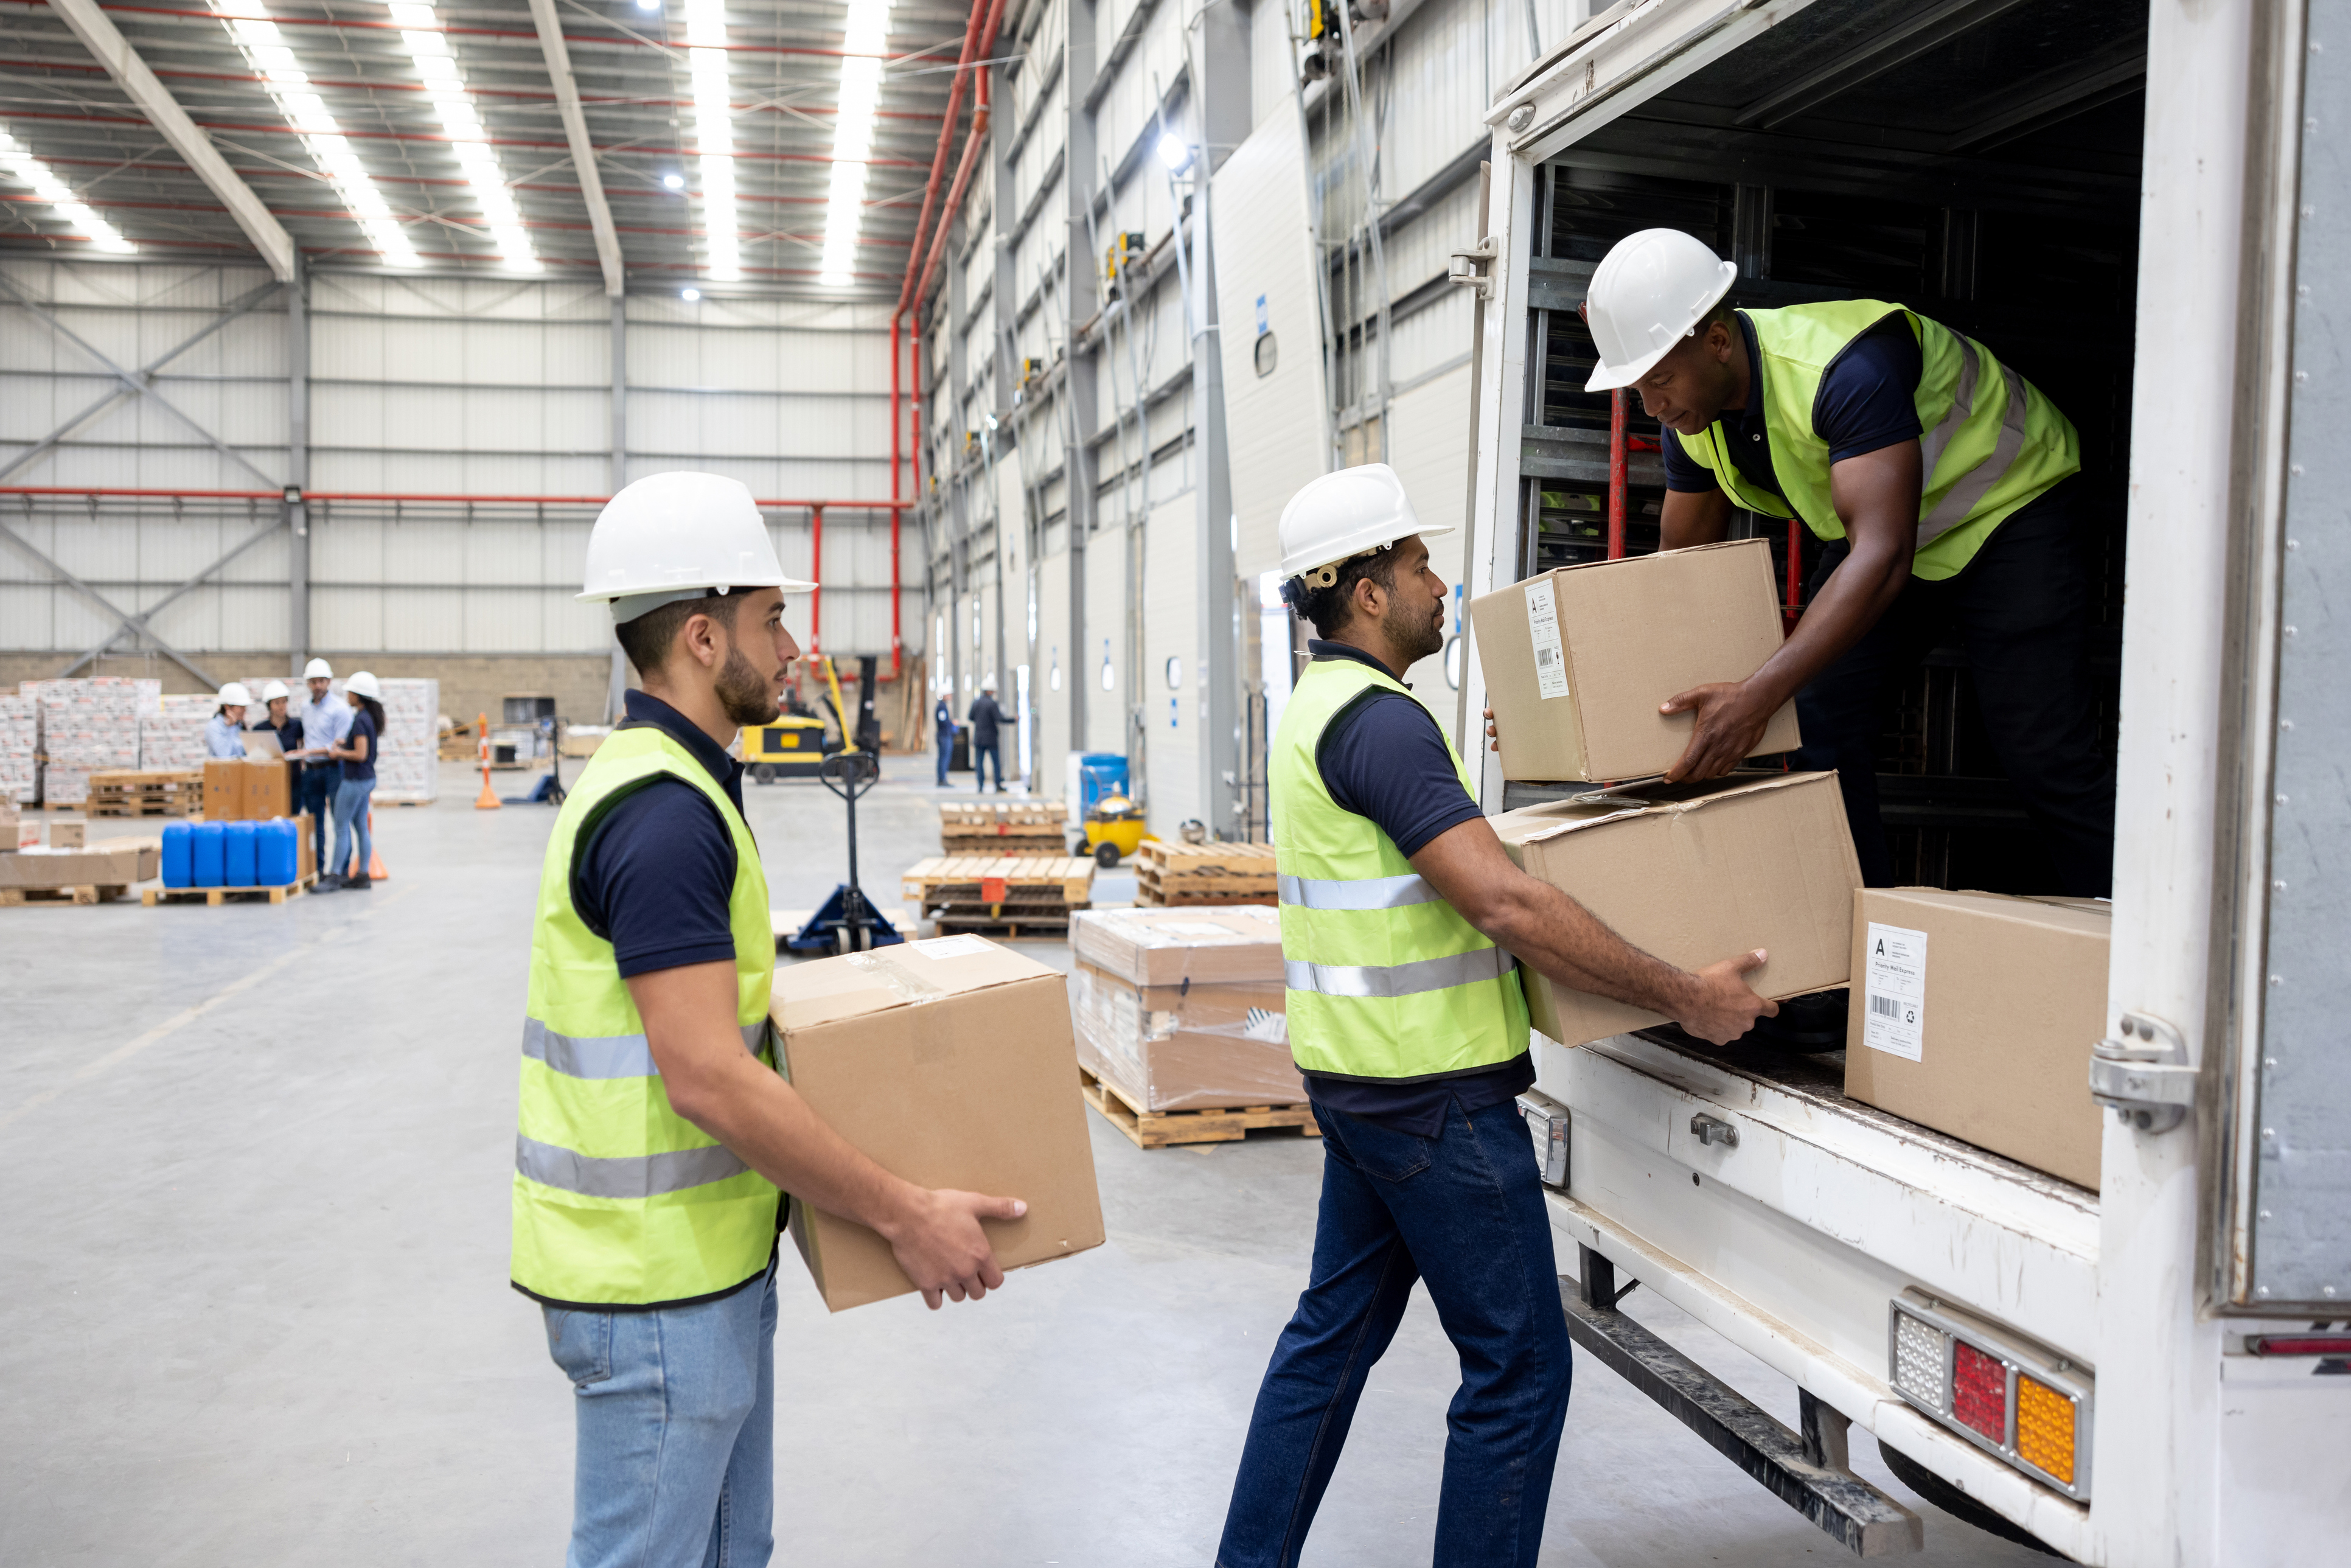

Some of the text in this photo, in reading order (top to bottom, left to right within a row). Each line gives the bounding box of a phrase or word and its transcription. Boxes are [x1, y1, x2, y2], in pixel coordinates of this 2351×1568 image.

[1532, 598, 1537, 613] A
[1876, 939, 1884, 956] A
[1875, 961, 1889, 970] Priority
[1899, 967, 1915, 975] Express
